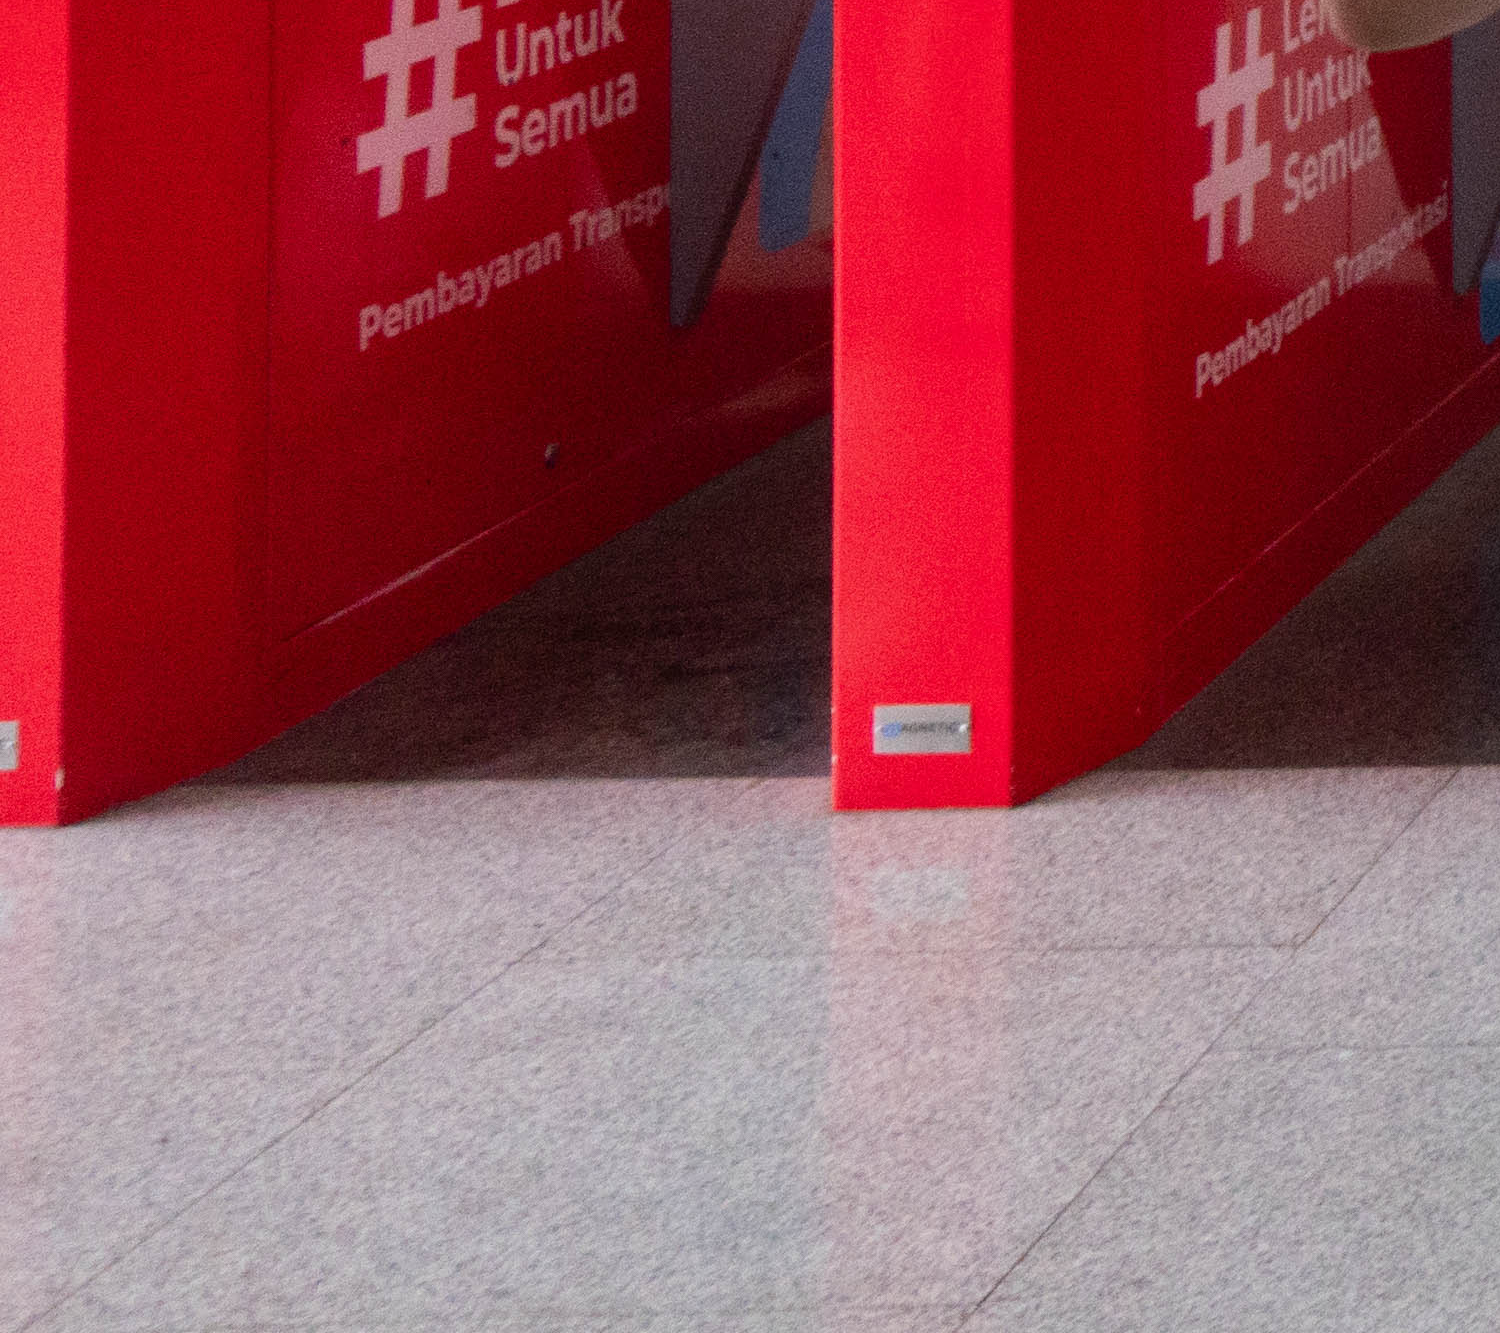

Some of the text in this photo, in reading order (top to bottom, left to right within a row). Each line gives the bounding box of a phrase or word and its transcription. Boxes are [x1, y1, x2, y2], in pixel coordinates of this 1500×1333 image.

[494, 71, 638, 169] Semua
[1283, 49, 1372, 133] Untuk
[1282, 114, 1382, 215] Semua
[358, 232, 562, 352] Pembayaran
[1195, 276, 1331, 399] Pembayaran
